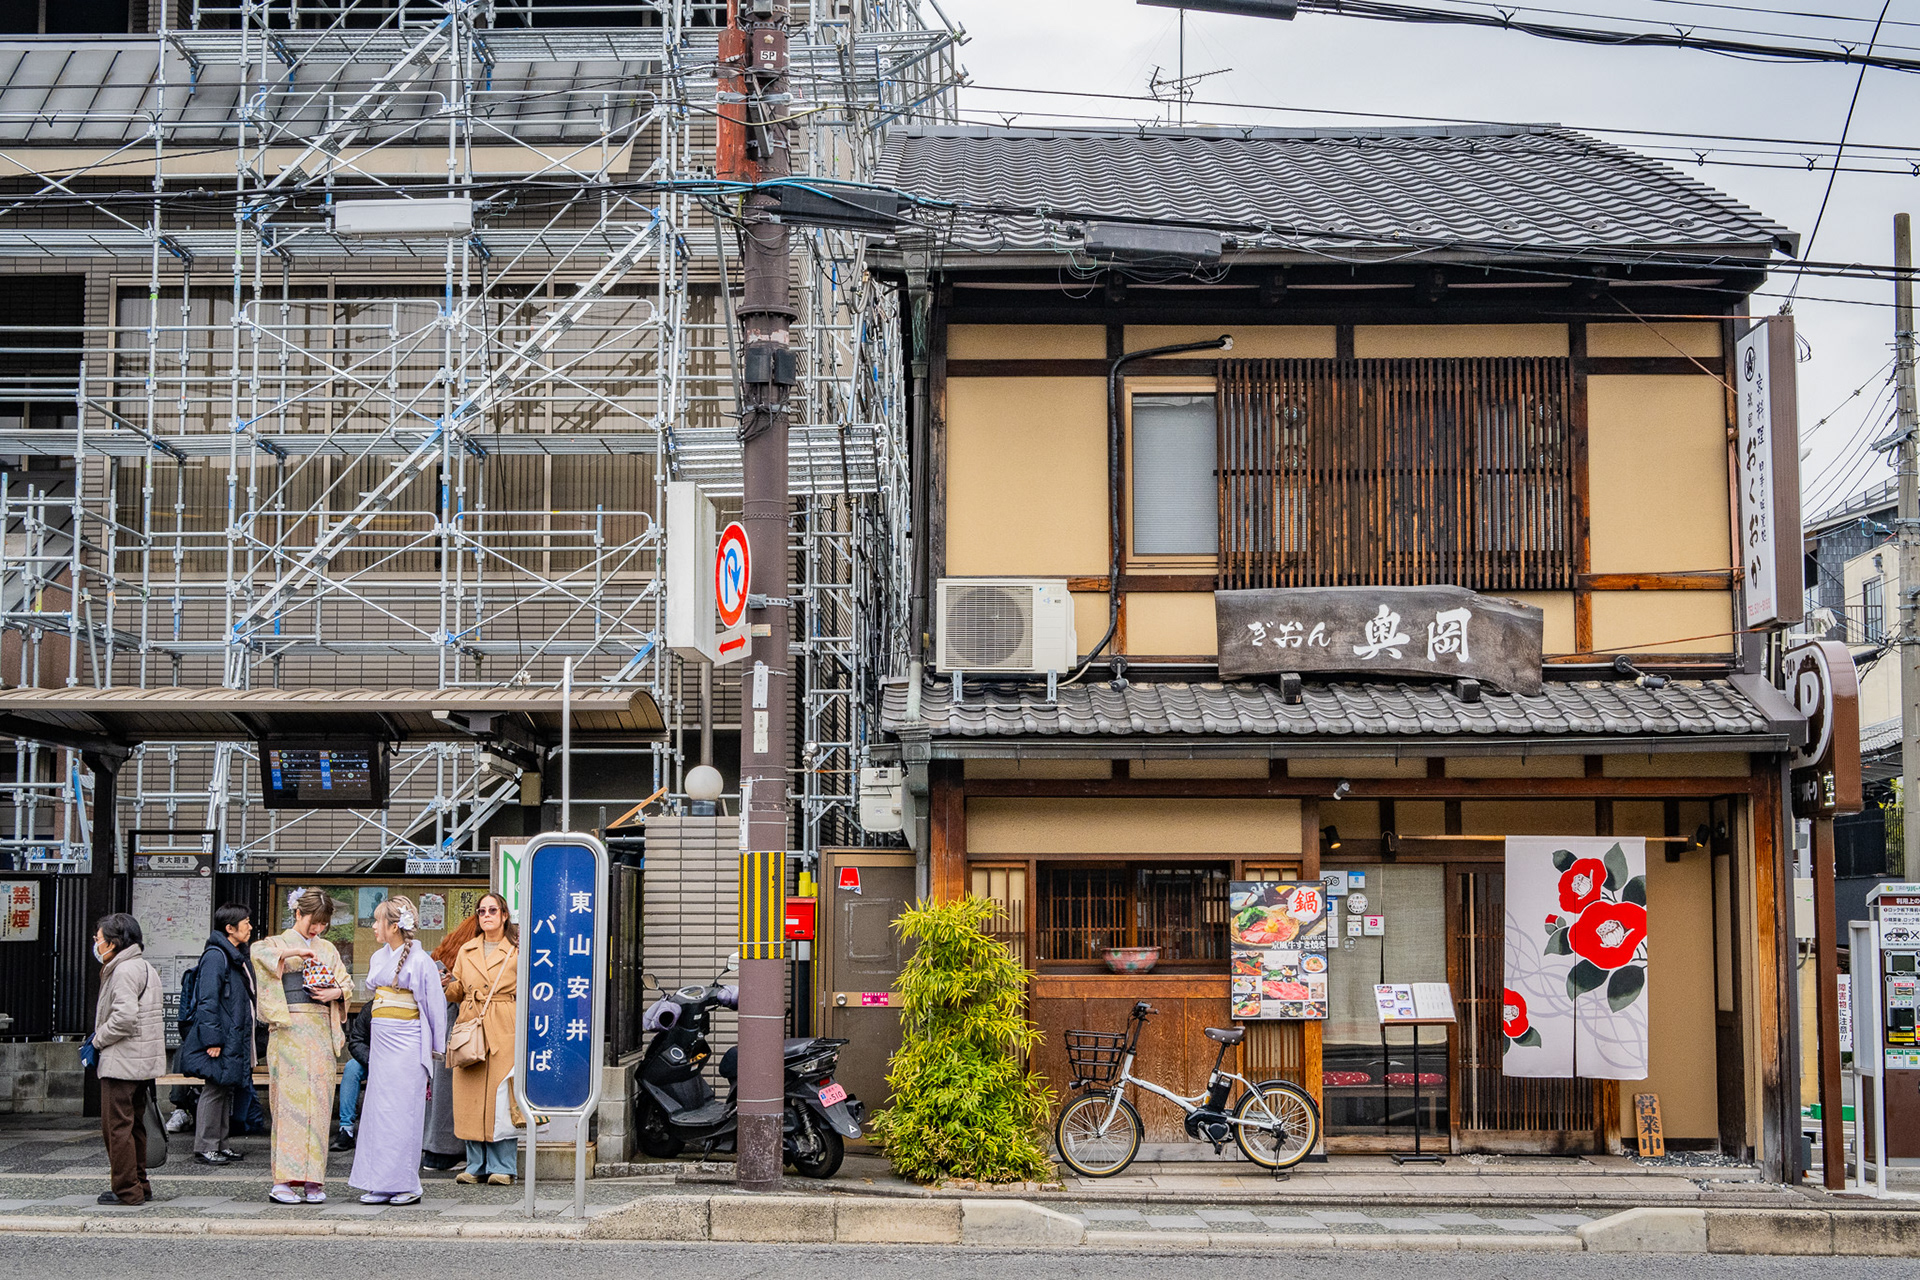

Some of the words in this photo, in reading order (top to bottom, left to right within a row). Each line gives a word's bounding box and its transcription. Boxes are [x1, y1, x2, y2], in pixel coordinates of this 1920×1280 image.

[762, 51, 775, 60] 5P
[1746, 436, 1762, 590] おくおか
[1247, 620, 1331, 648] ぎおん
[1353, 603, 1472, 663] 奥岡
[12, 886, 30, 928] 禁煙
[460, 890, 473, 920] 般若
[1293, 890, 1318, 914] 鍋
[566, 890, 592, 1042] 東山安井
[1271, 941, 1326, 950] 京風牛すき焼き
[530, 914, 556, 1072] バスのりば
[1638, 1095, 1661, 1155] 営業中
